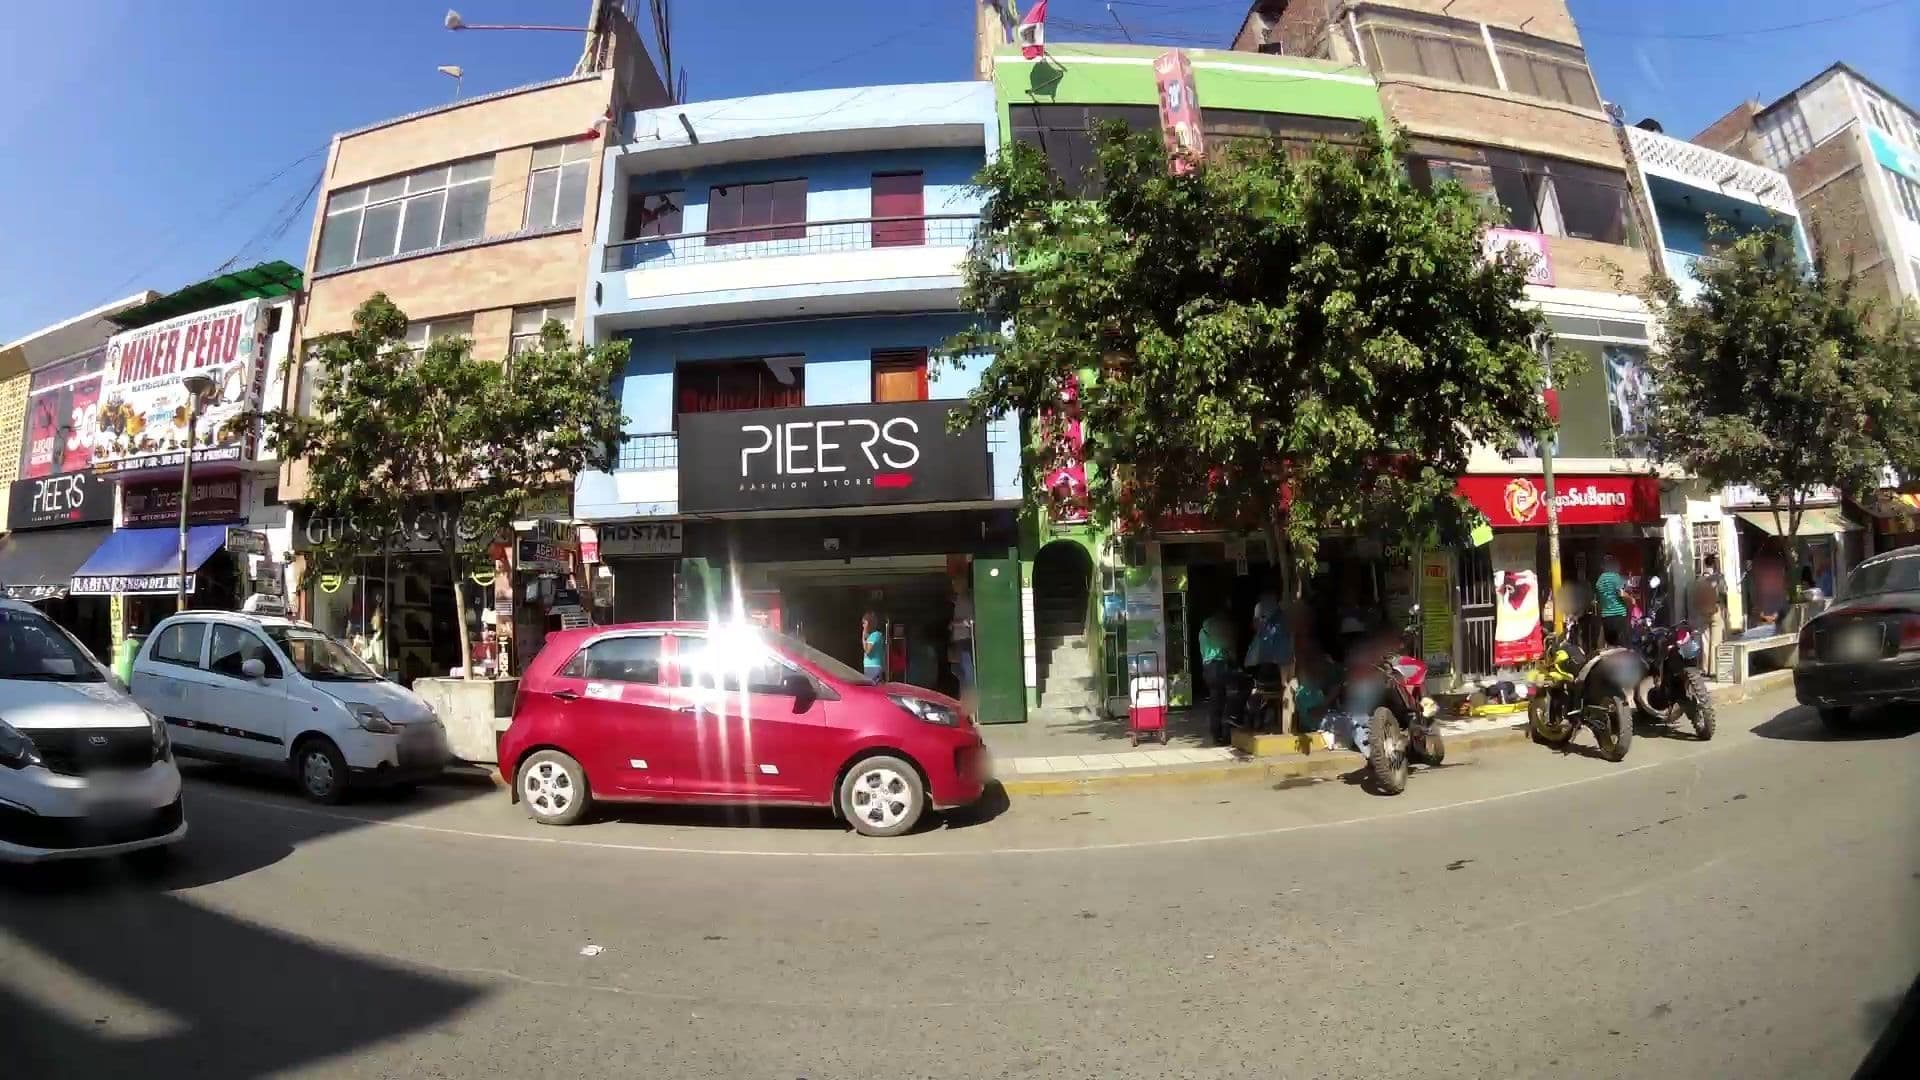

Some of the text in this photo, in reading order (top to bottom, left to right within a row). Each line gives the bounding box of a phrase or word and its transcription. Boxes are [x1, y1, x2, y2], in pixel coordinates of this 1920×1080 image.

[117, 328, 181, 385] MINER
[180, 313, 242, 372] PERU
[742, 417, 920, 477] PIEERS
[32, 473, 85, 513] PIEERS
[823, 477, 873, 488] STORE
[602, 525, 681, 541] HOSTAL
